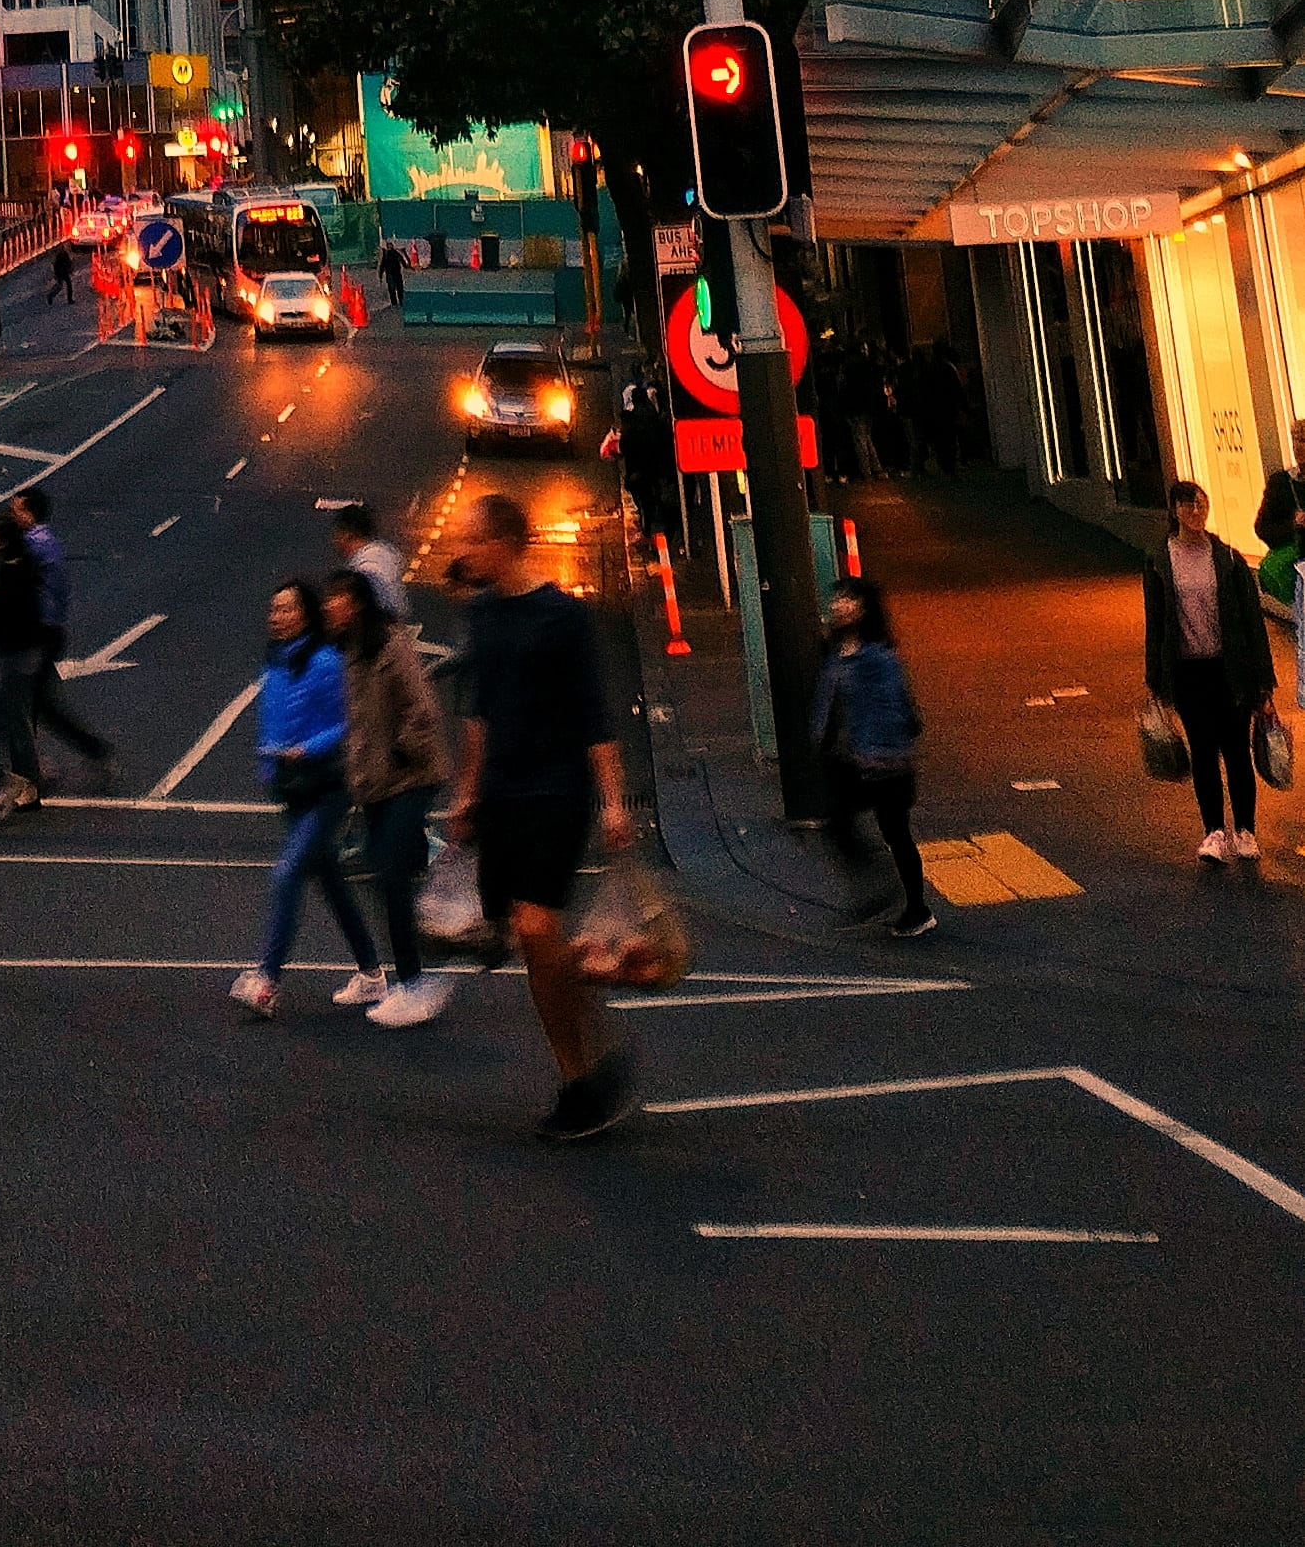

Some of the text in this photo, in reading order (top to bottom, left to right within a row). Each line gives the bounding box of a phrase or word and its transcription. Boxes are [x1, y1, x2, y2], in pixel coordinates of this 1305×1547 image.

[979, 198, 1152, 239] TOPSHOP
[658, 231, 682, 245] BUS
[671, 244, 693, 259] AHE
